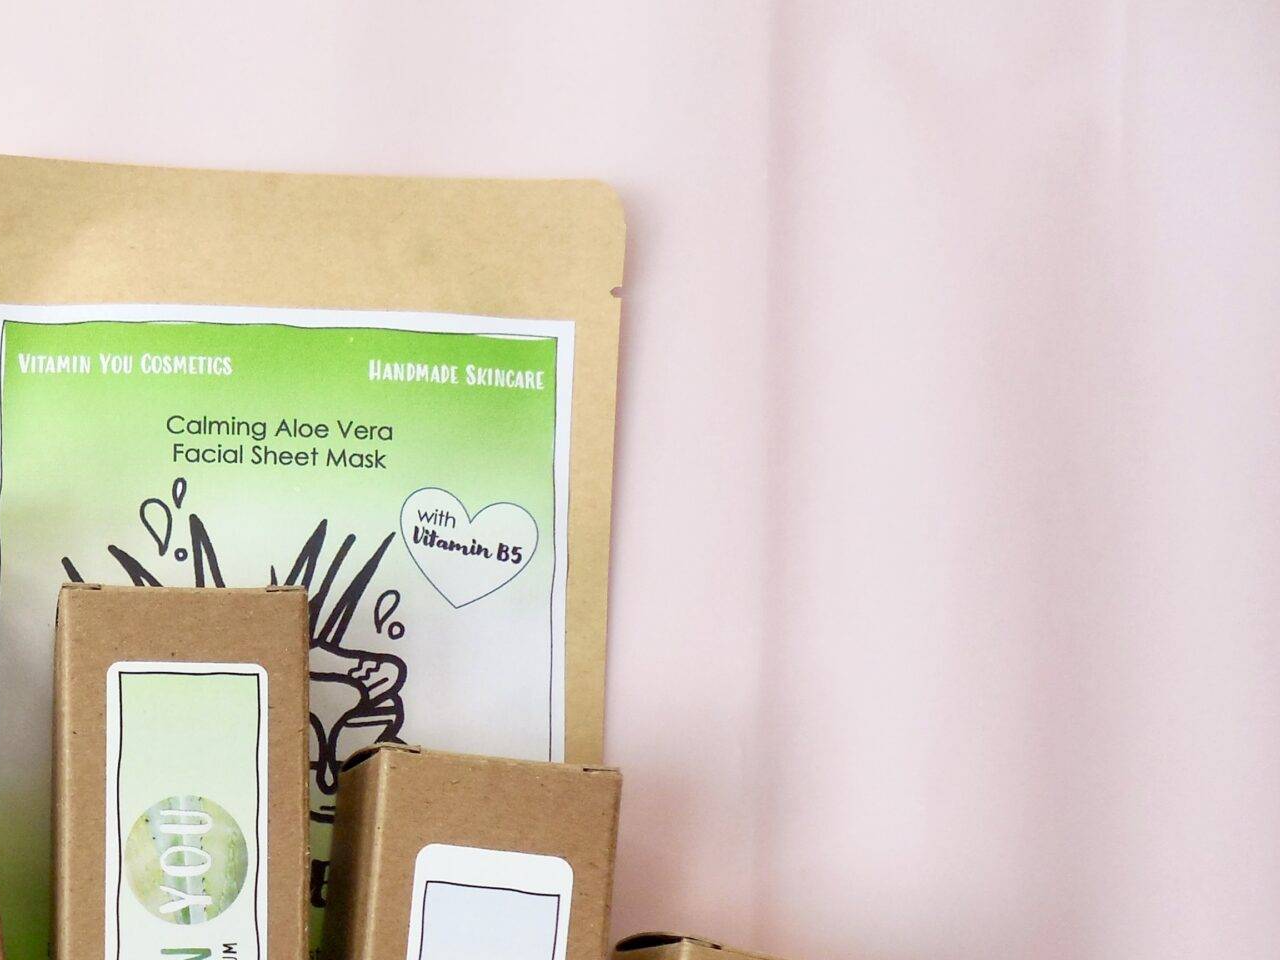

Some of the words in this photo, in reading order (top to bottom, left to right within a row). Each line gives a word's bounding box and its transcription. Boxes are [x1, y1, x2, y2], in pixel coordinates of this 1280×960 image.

[18, 353, 91, 374] VITAMIN
[99, 353, 133, 374] YOU
[140, 353, 233, 376] COSMETICS
[368, 359, 460, 385] HANDMADE
[464, 364, 545, 389] SKINCARE
[166, 416, 267, 441] Calming
[274, 418, 328, 439] Aloe
[337, 421, 393, 442] Vera
[173, 443, 243, 465] Facial
[250, 445, 320, 468] Sheet
[326, 447, 387, 469] Mask
[417, 508, 456, 529] with
[411, 526, 493, 560] Vitamin
[497, 544, 523, 565] B5
[159, 810, 212, 913] YOU
